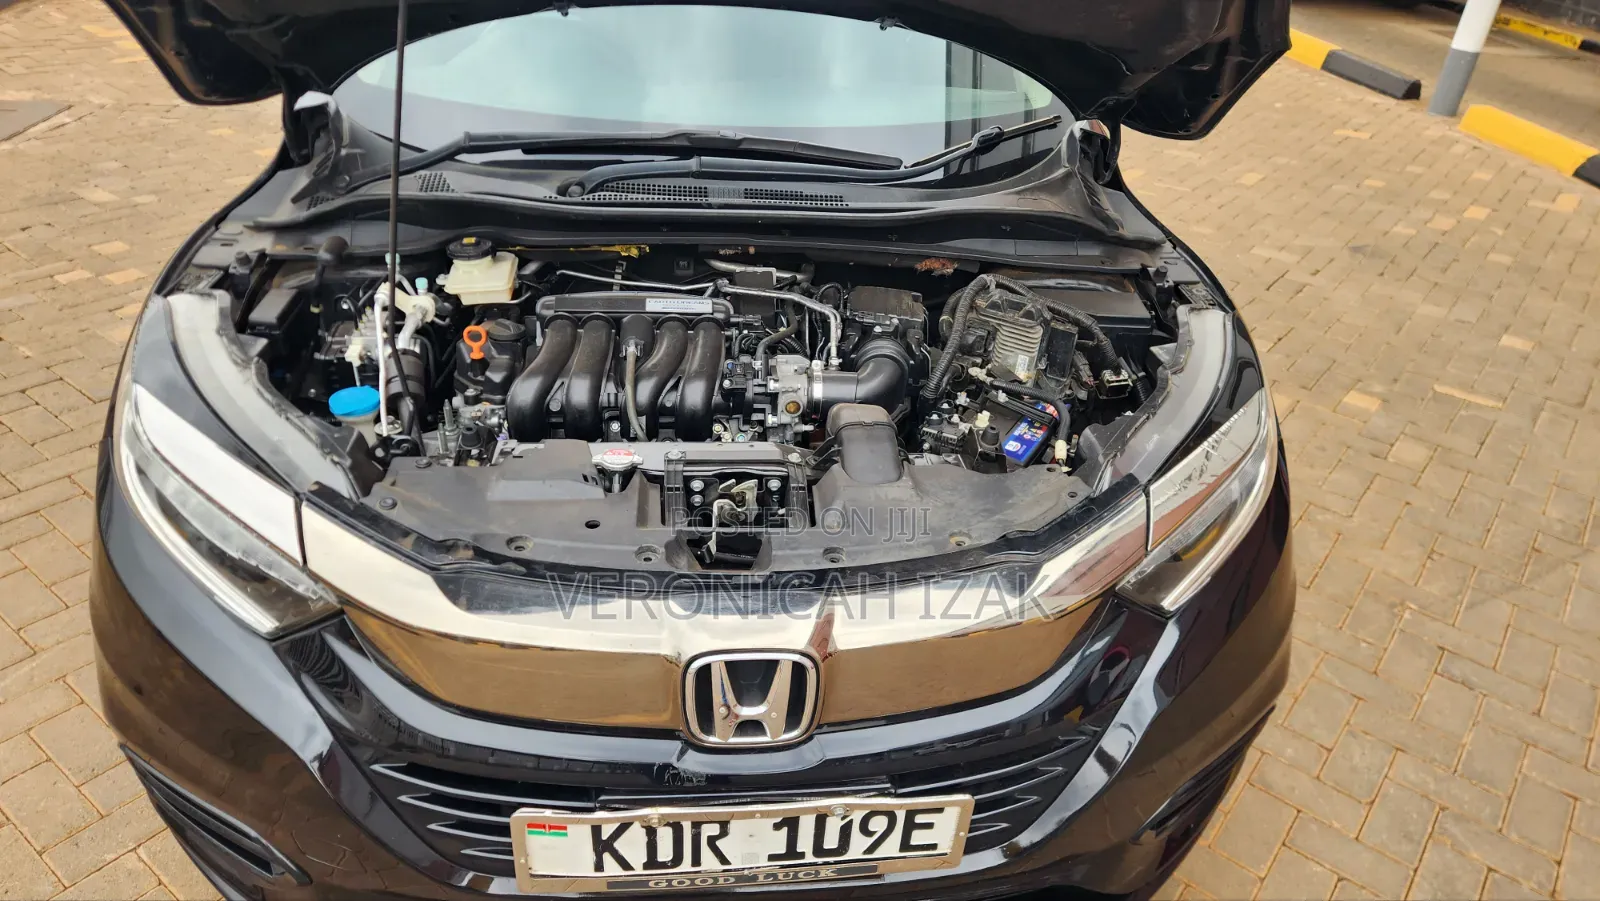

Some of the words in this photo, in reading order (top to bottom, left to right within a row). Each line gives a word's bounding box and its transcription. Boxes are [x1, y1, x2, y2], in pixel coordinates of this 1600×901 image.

[591, 820, 732, 872] KDR
[767, 807, 946, 862] 109E
[648, 876, 735, 888] GOOD
[756, 869, 838, 882] LUCK
